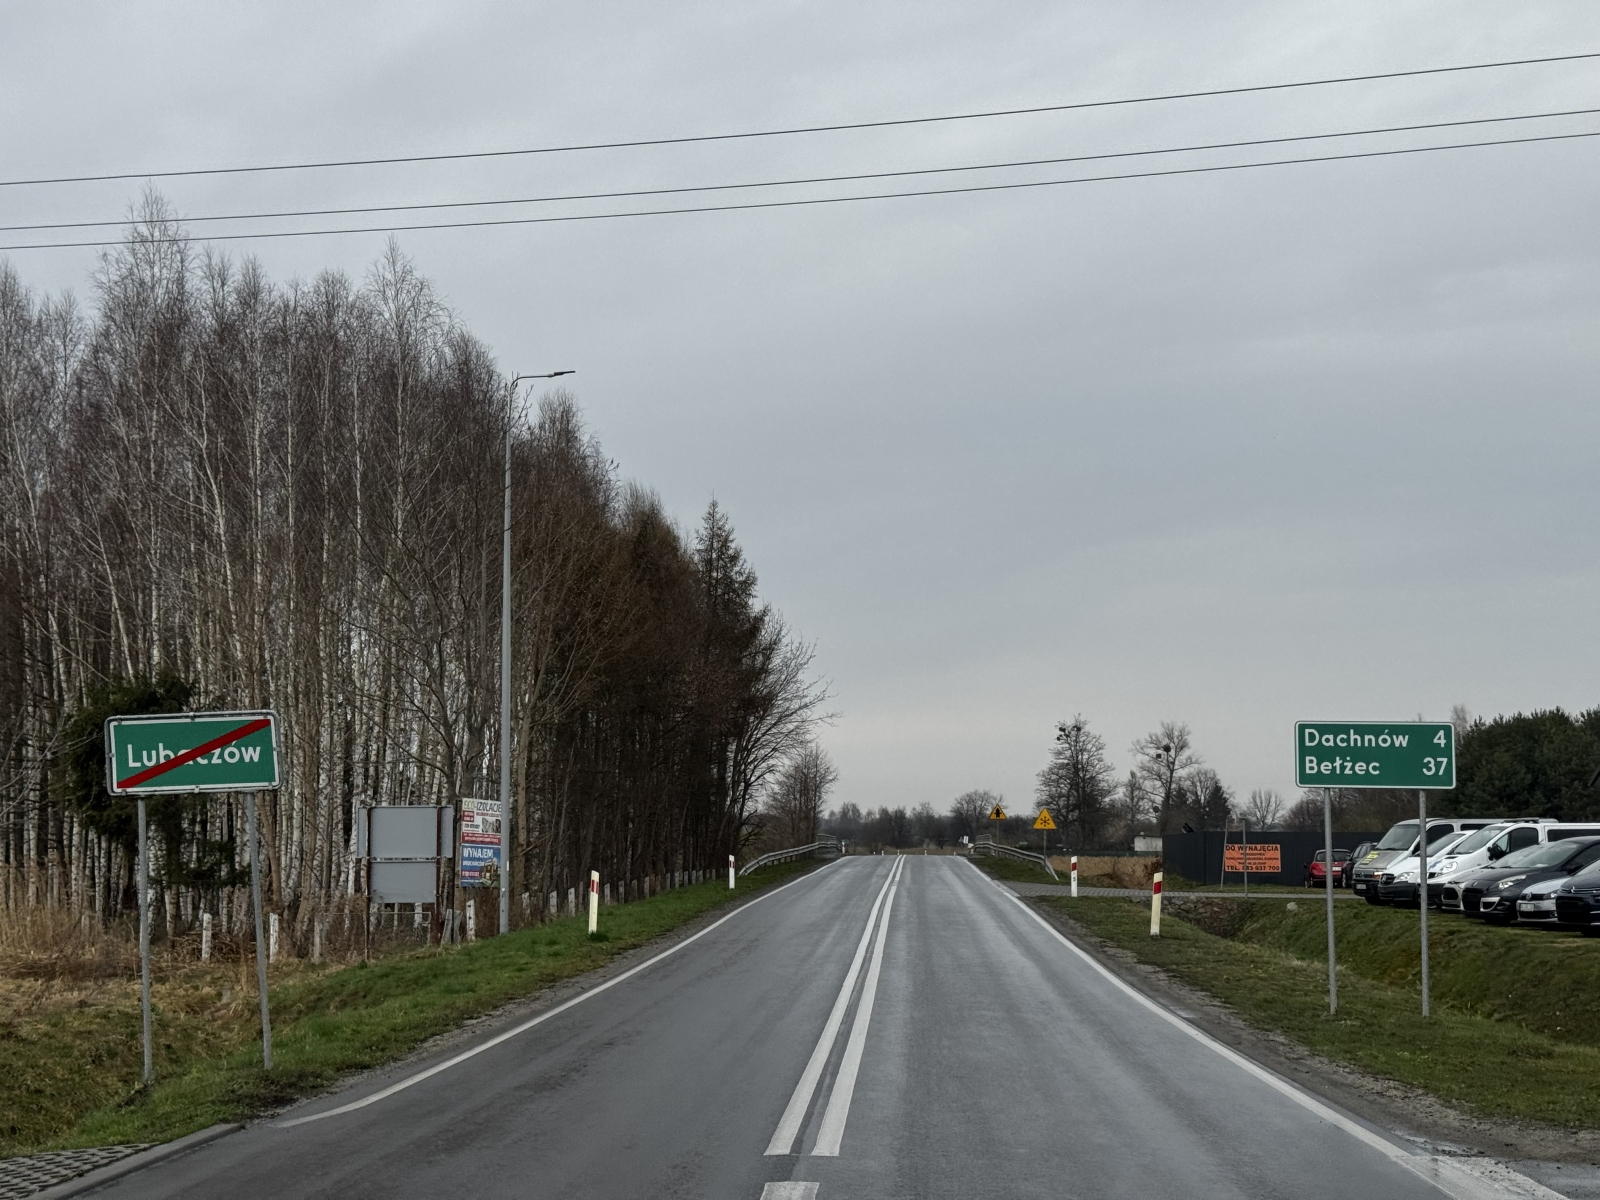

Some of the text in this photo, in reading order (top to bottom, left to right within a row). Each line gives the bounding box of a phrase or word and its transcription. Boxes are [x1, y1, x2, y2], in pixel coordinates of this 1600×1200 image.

[1304, 728, 1447, 748] Dachnów 4
[1305, 756, 1448, 776] Bełżec 37
[463, 847, 493, 858] WYNAJEM
